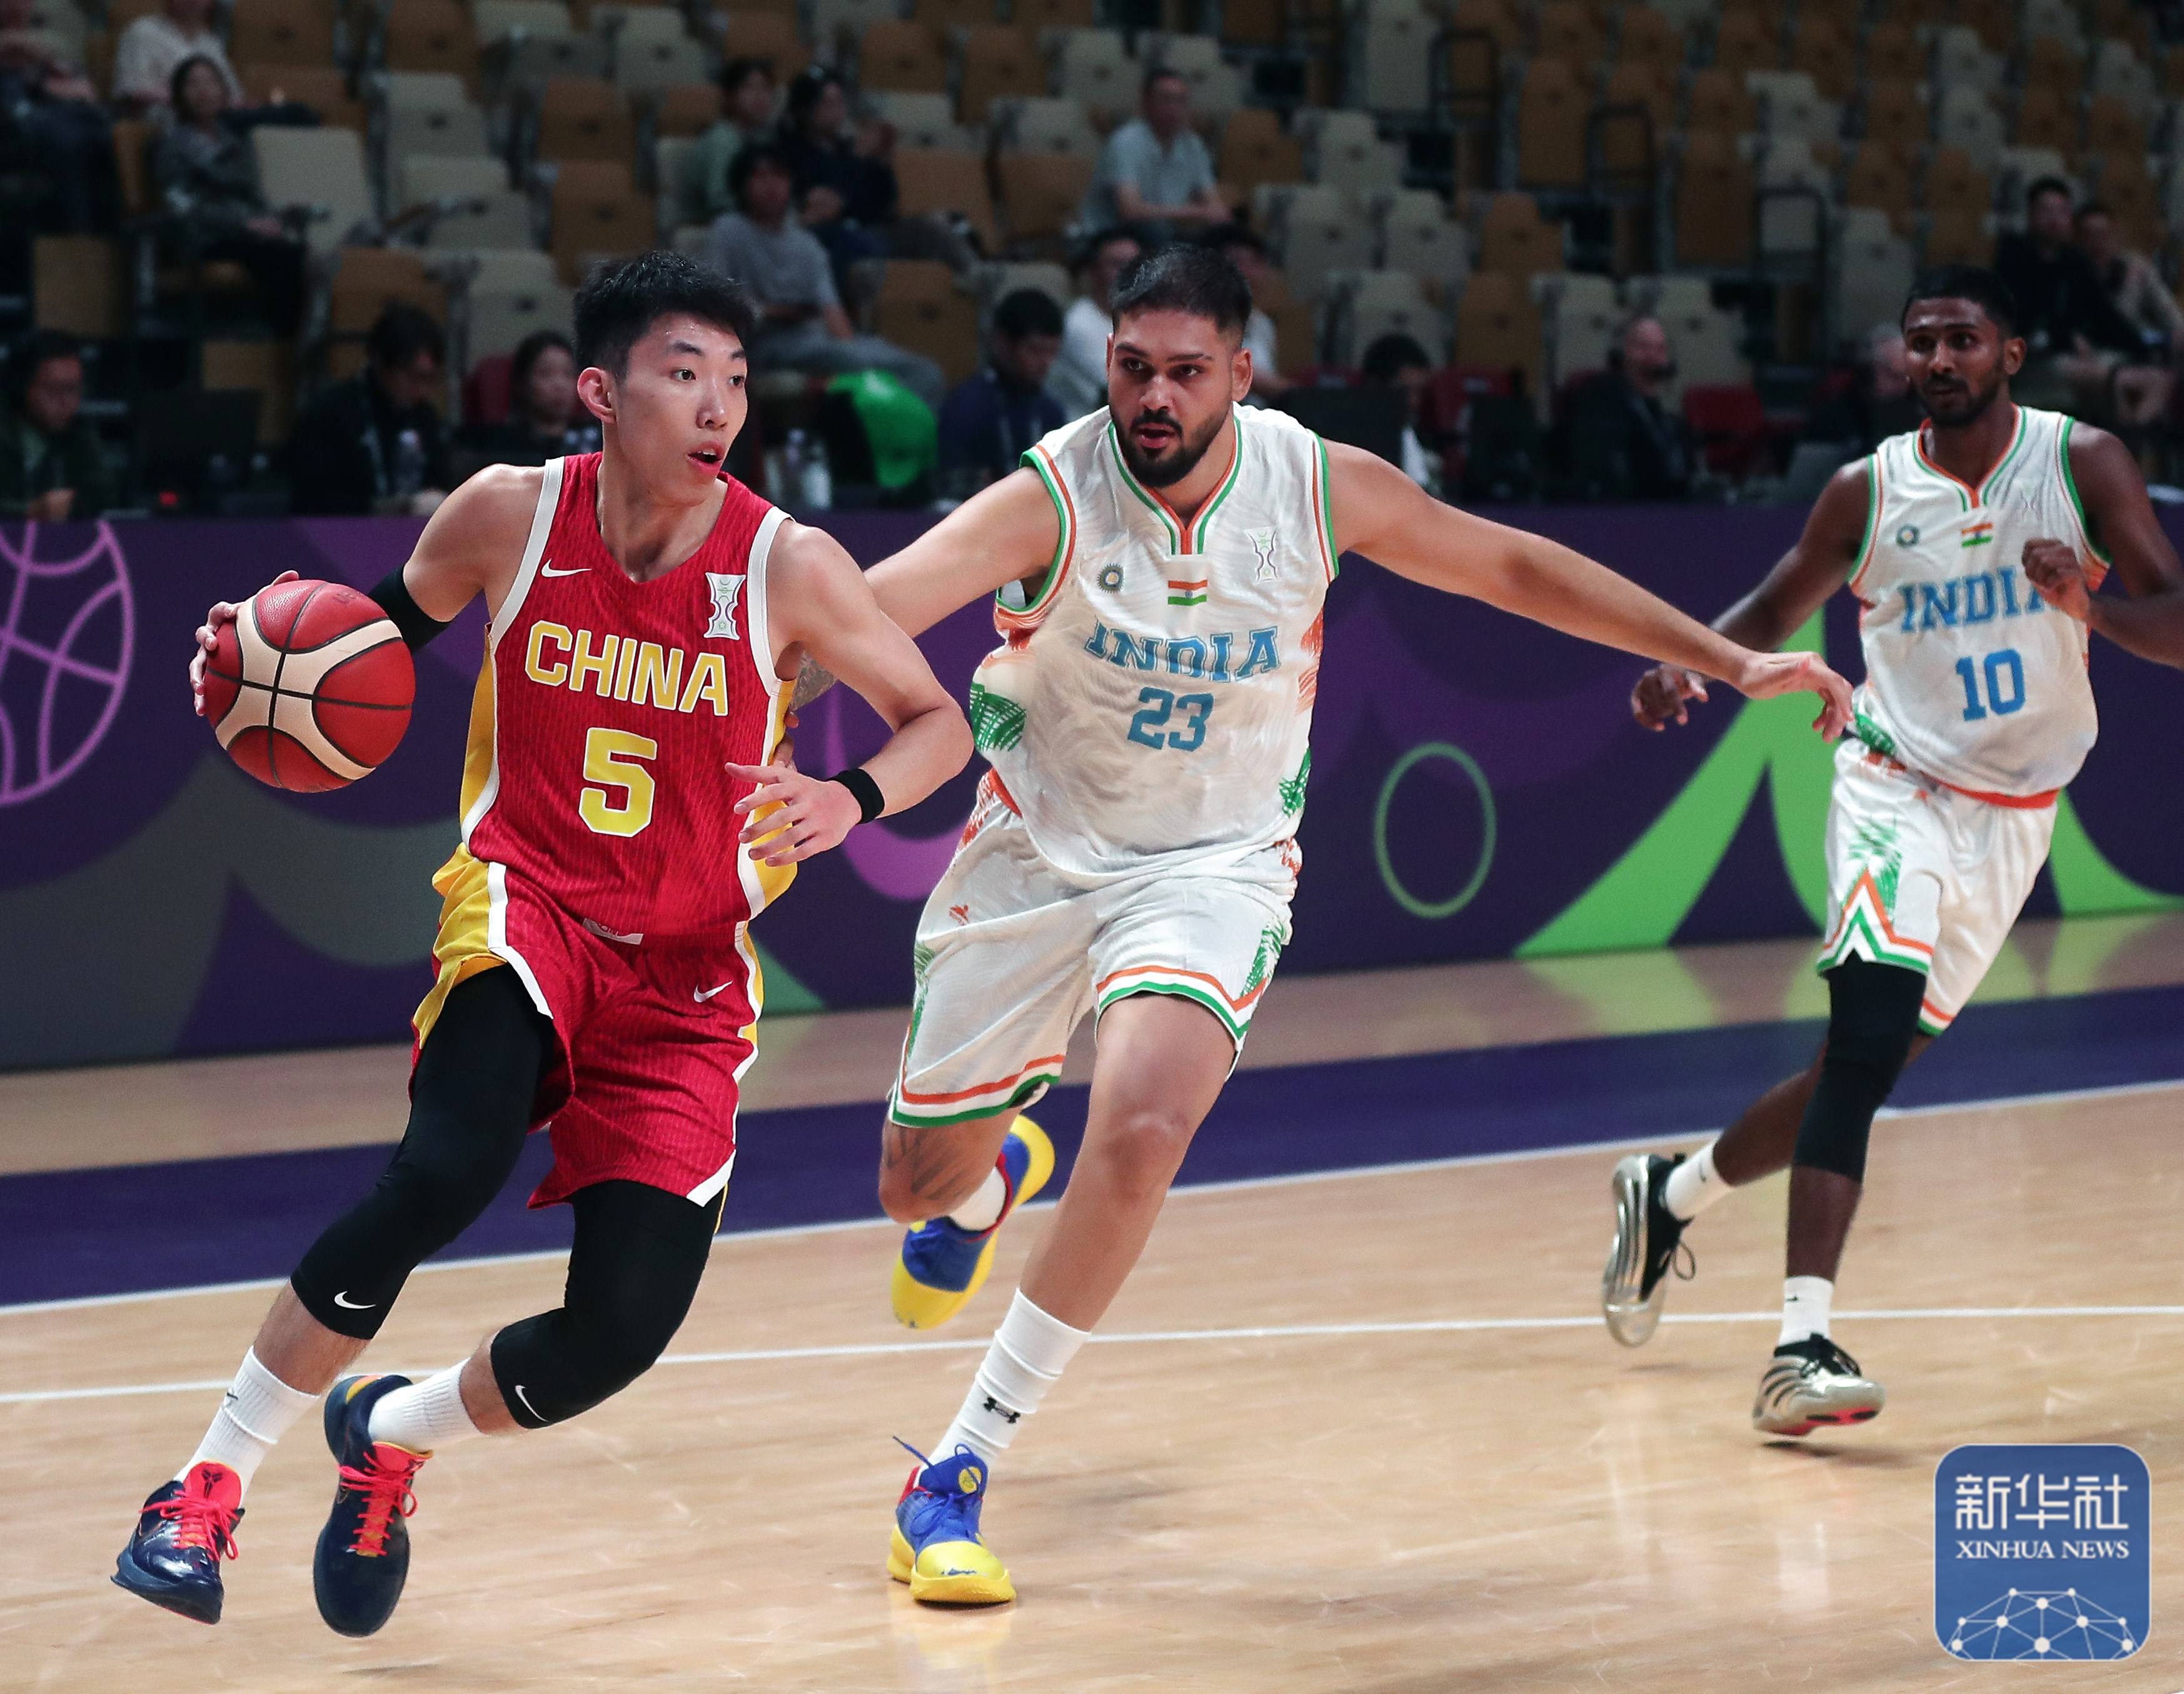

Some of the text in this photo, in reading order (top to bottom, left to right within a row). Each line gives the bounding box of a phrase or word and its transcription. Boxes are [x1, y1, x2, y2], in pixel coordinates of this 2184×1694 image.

[1898, 565, 2060, 633] INDI
[525, 620, 728, 716] CHINA
[1085, 619, 1281, 683] INDIA
[1955, 648, 2026, 721] 10
[1127, 686, 1214, 752] 23
[579, 727, 658, 838] 5
